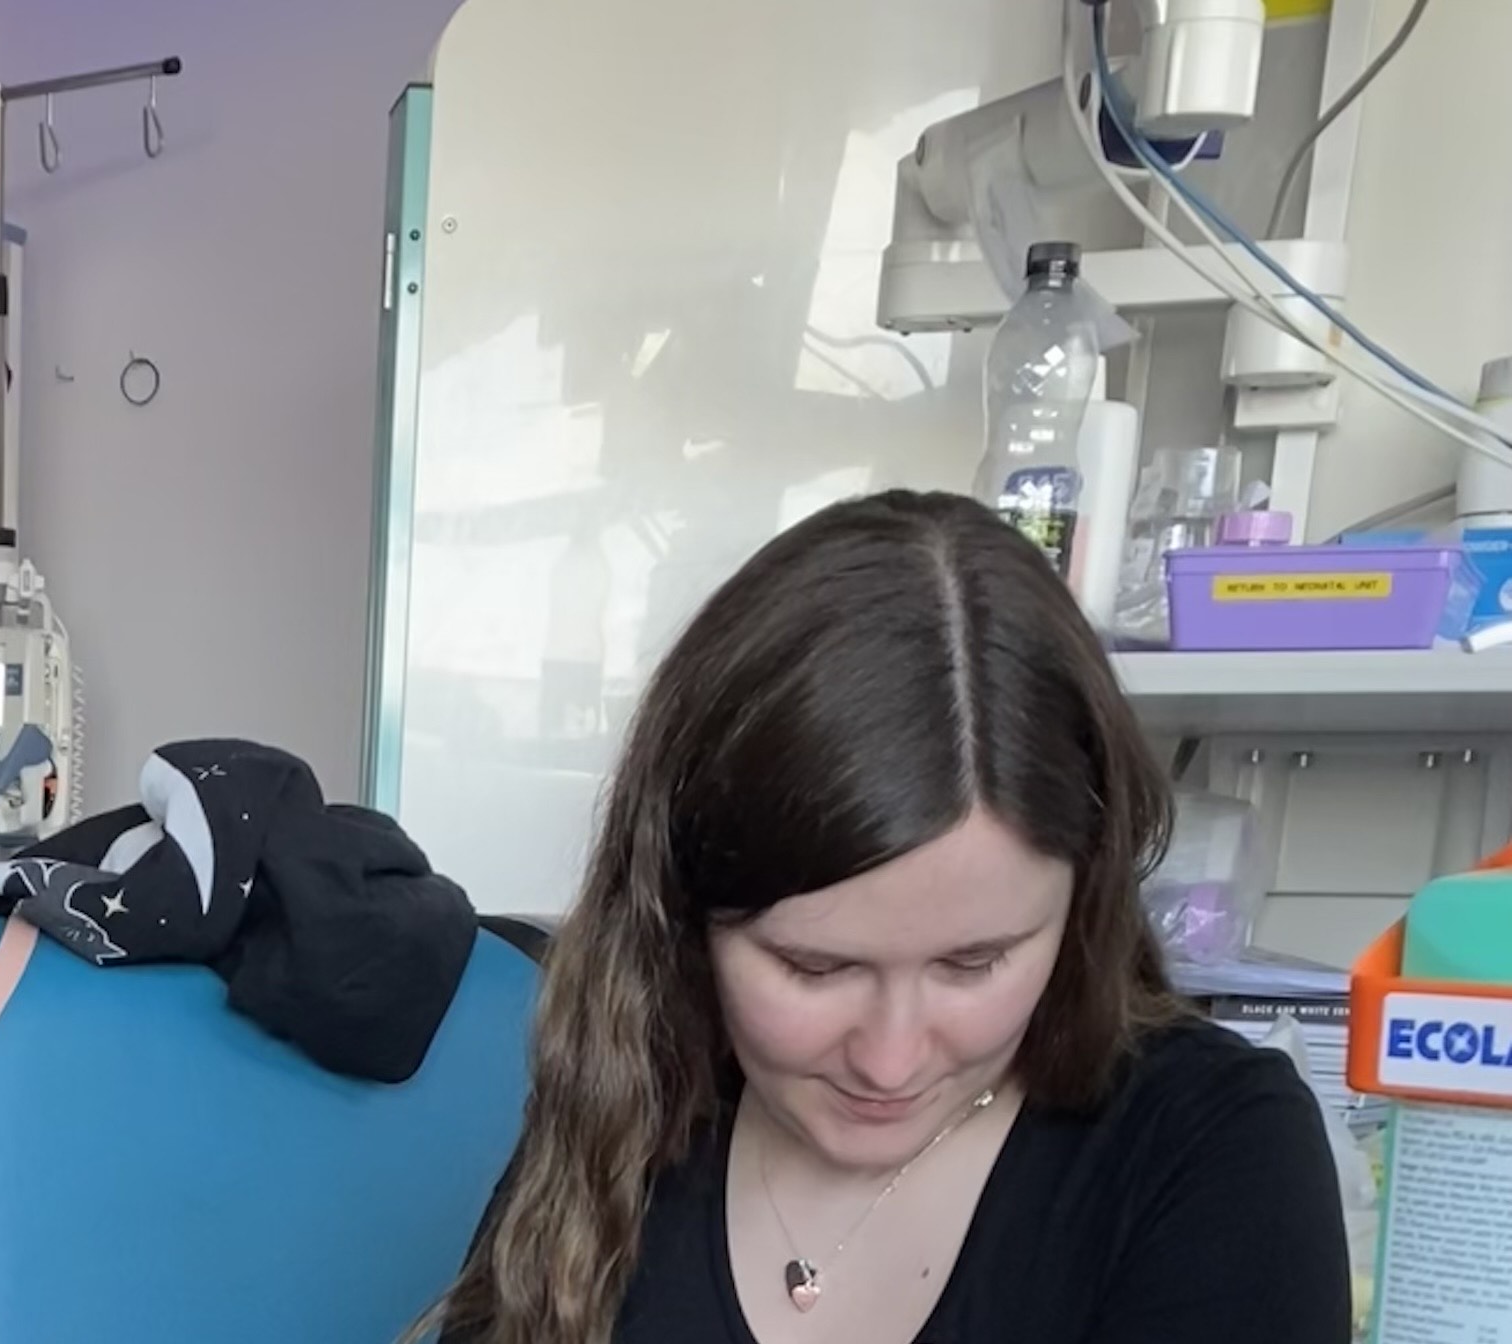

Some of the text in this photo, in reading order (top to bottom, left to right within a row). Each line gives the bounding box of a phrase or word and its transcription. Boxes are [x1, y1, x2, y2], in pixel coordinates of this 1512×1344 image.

[1226, 581, 1265, 593] RETURN
[1273, 581, 1288, 592] TO
[1241, 1004, 1273, 1015] BLACK
[1299, 1005, 1330, 1017] WHITE
[1387, 1017, 1512, 1067] ECOL
